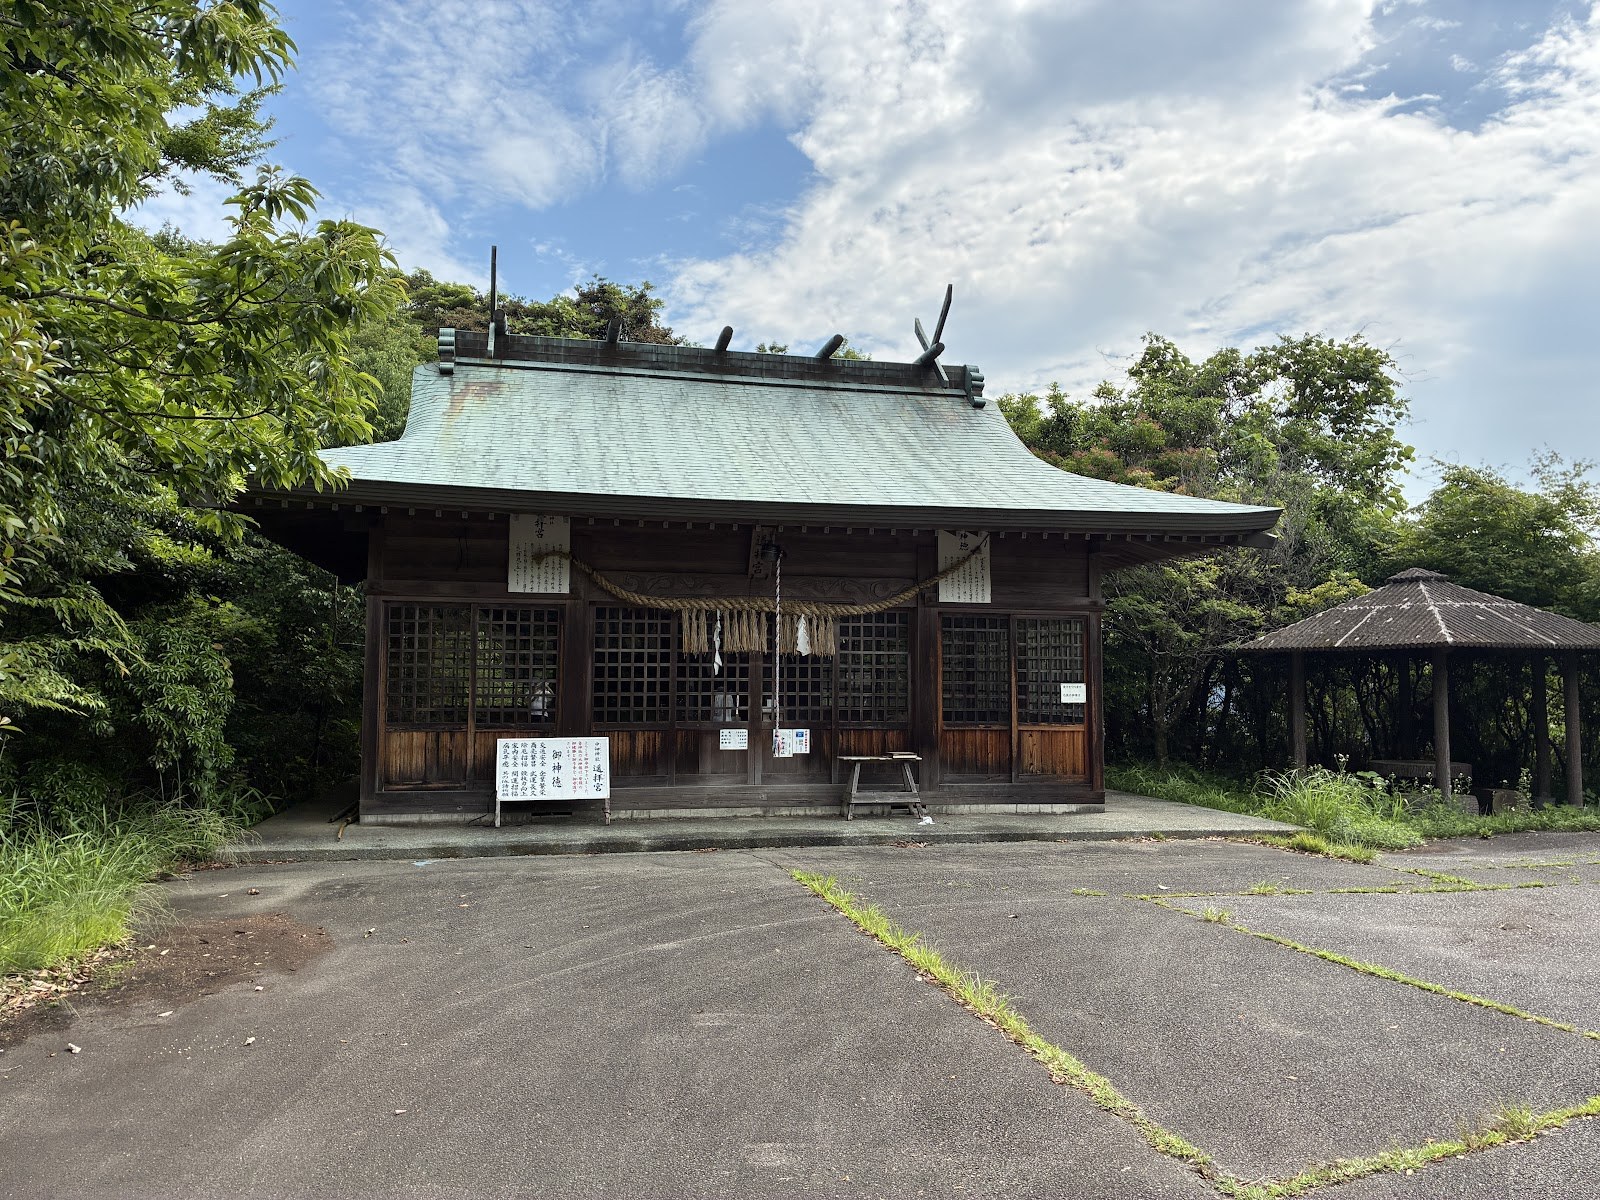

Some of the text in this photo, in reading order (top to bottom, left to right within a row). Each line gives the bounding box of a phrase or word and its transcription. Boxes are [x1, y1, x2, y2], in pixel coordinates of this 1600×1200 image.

[511, 742, 519, 797] 家内安全 開運招福
[529, 770, 537, 796] 武運長久
[539, 742, 547, 796] 交通安全 企業繁栄
[552, 749, 563, 788] 御神徳
